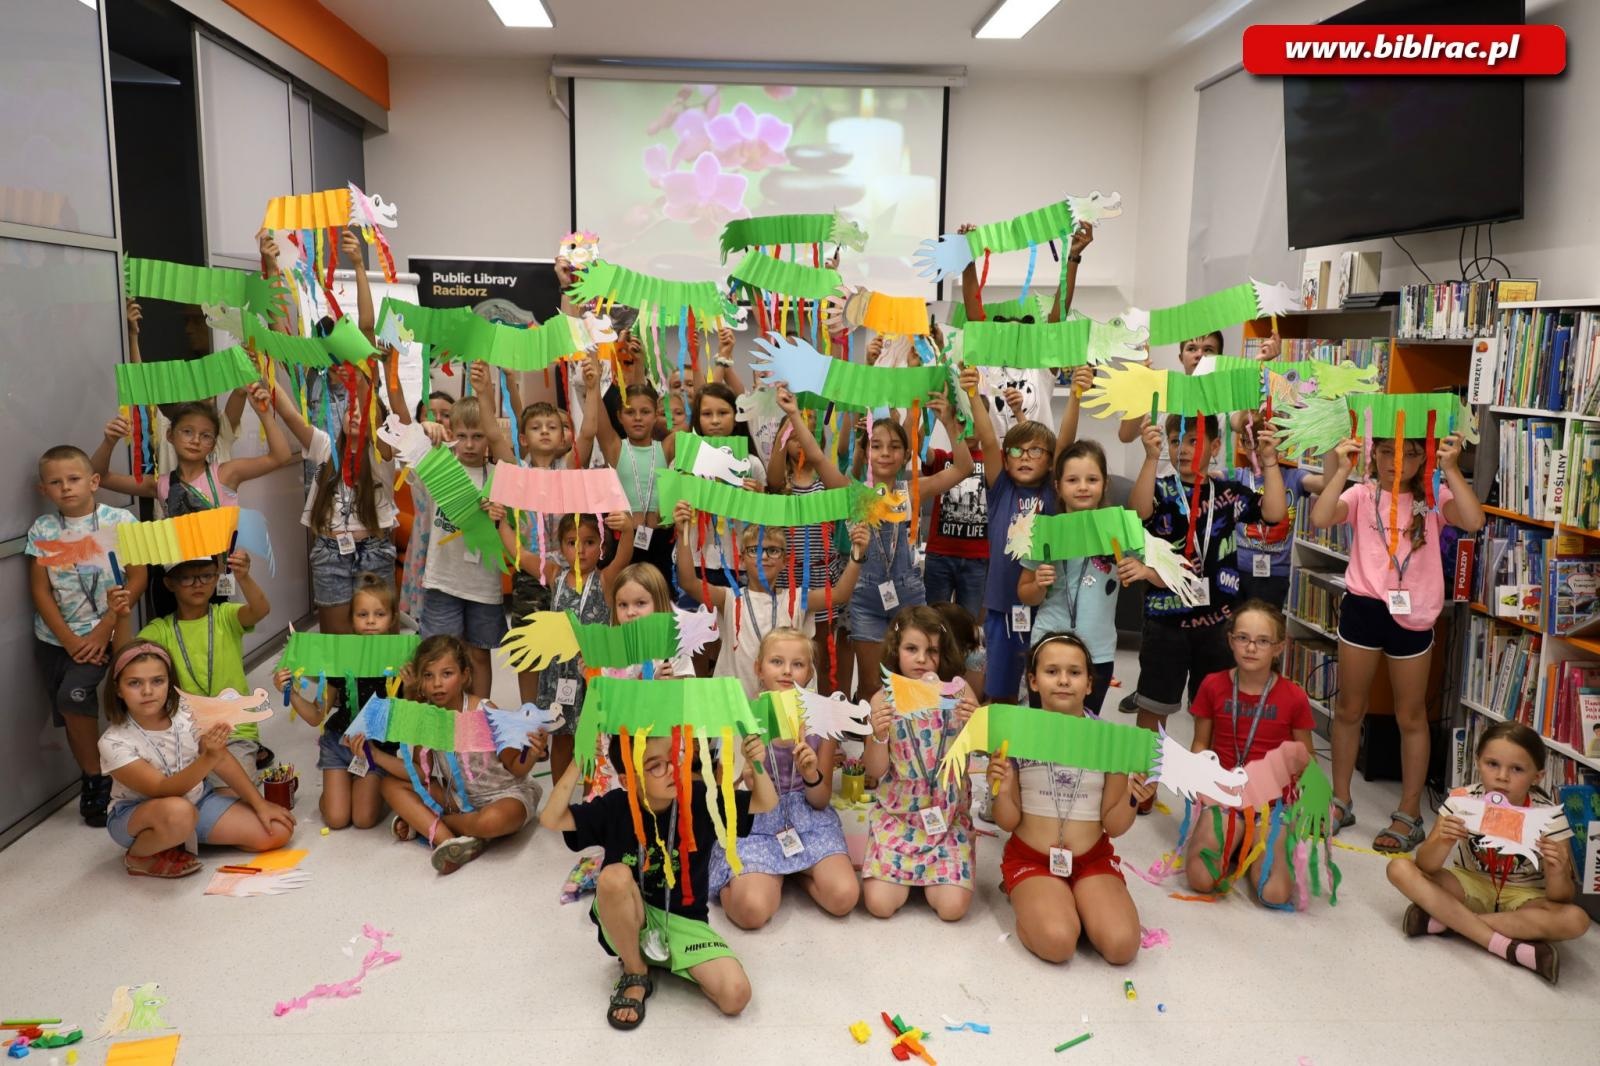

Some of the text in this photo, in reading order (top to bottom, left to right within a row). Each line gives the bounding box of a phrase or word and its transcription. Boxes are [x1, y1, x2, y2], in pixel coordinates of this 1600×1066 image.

[432, 272, 517, 287] Public Library
[432, 285, 488, 297] Raciborz
[1472, 357, 1482, 402] ZWIERZĘTA
[1553, 453, 1568, 503] ROŚLINY
[942, 522, 985, 537] CITY LIFE
[1458, 551, 1468, 589] POJAZDY
